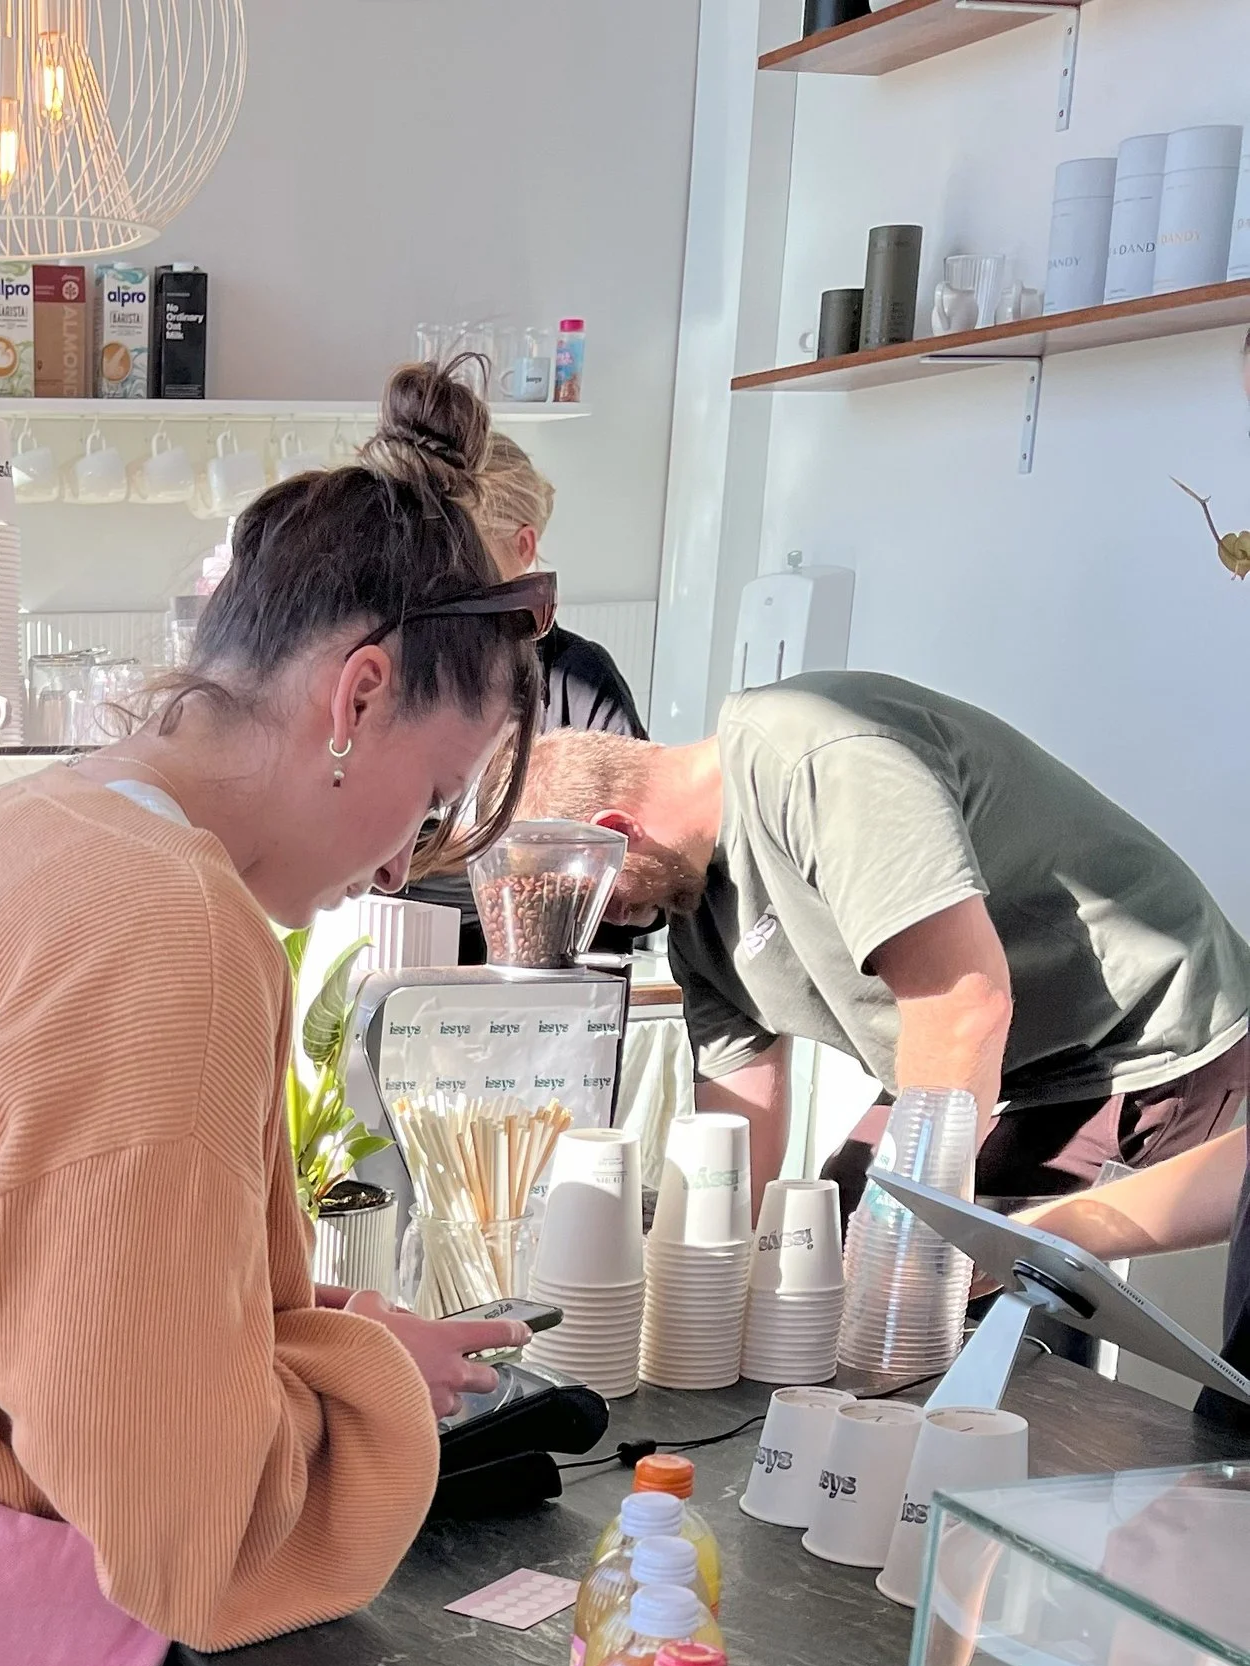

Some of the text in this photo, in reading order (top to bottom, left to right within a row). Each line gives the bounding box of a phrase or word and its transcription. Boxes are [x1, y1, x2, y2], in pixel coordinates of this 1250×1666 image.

[1119, 242, 1156, 256] DAND
[108, 286, 146, 307] alpro
[166, 303, 179, 312] No
[166, 312, 204, 324] Ordinary
[166, 322, 182, 331] Oat
[166, 331, 184, 340] Milk
[390, 1020, 616, 1038] issys issys issys issys issys
[385, 1074, 611, 1093] issys issys issys issys issys
[758, 1228, 814, 1251] issys
[900, 1493, 930, 1524] iss
